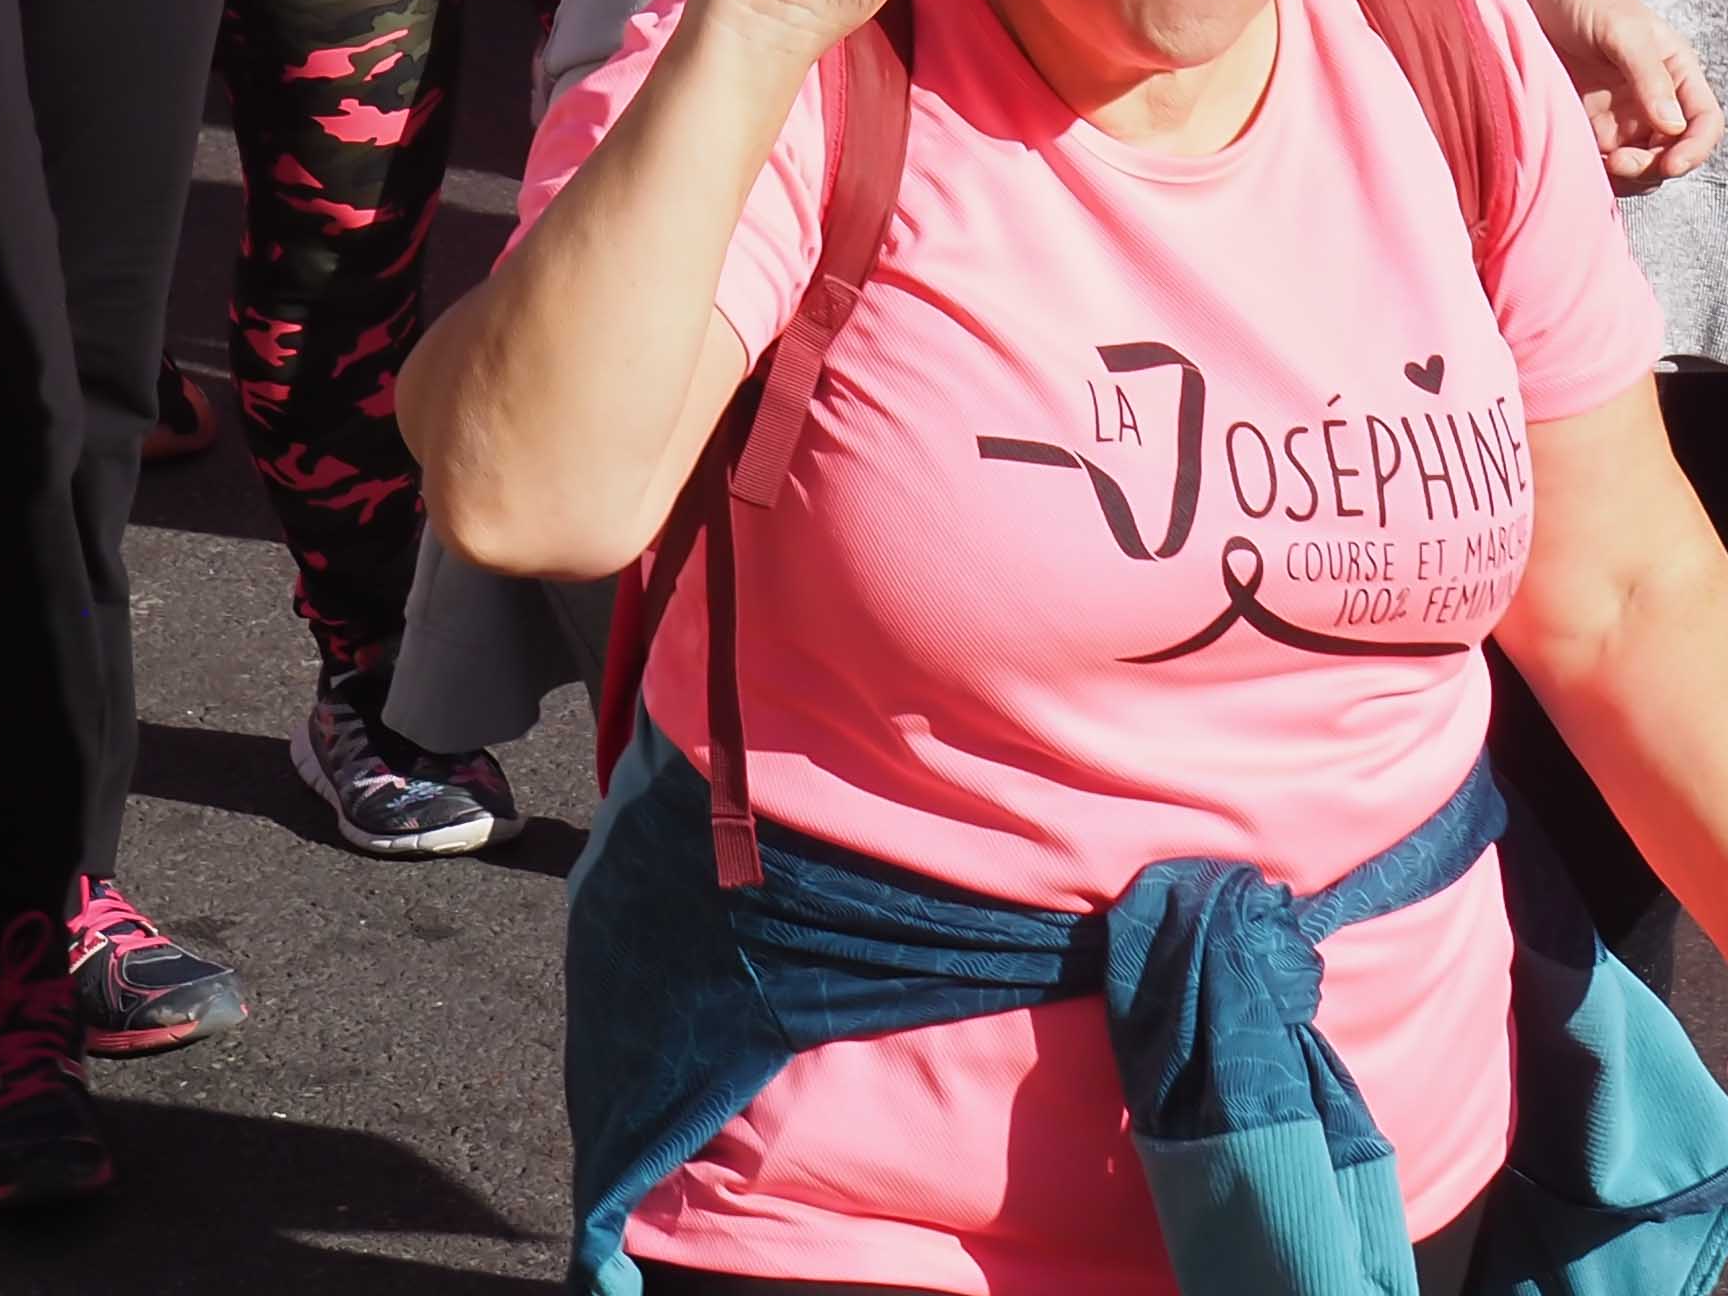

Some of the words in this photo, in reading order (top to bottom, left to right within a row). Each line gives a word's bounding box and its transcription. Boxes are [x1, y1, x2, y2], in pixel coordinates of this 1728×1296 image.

[1087, 379, 1143, 447] LA
[1286, 541, 1395, 584] COURSE
[1417, 538, 1447, 581] ET
